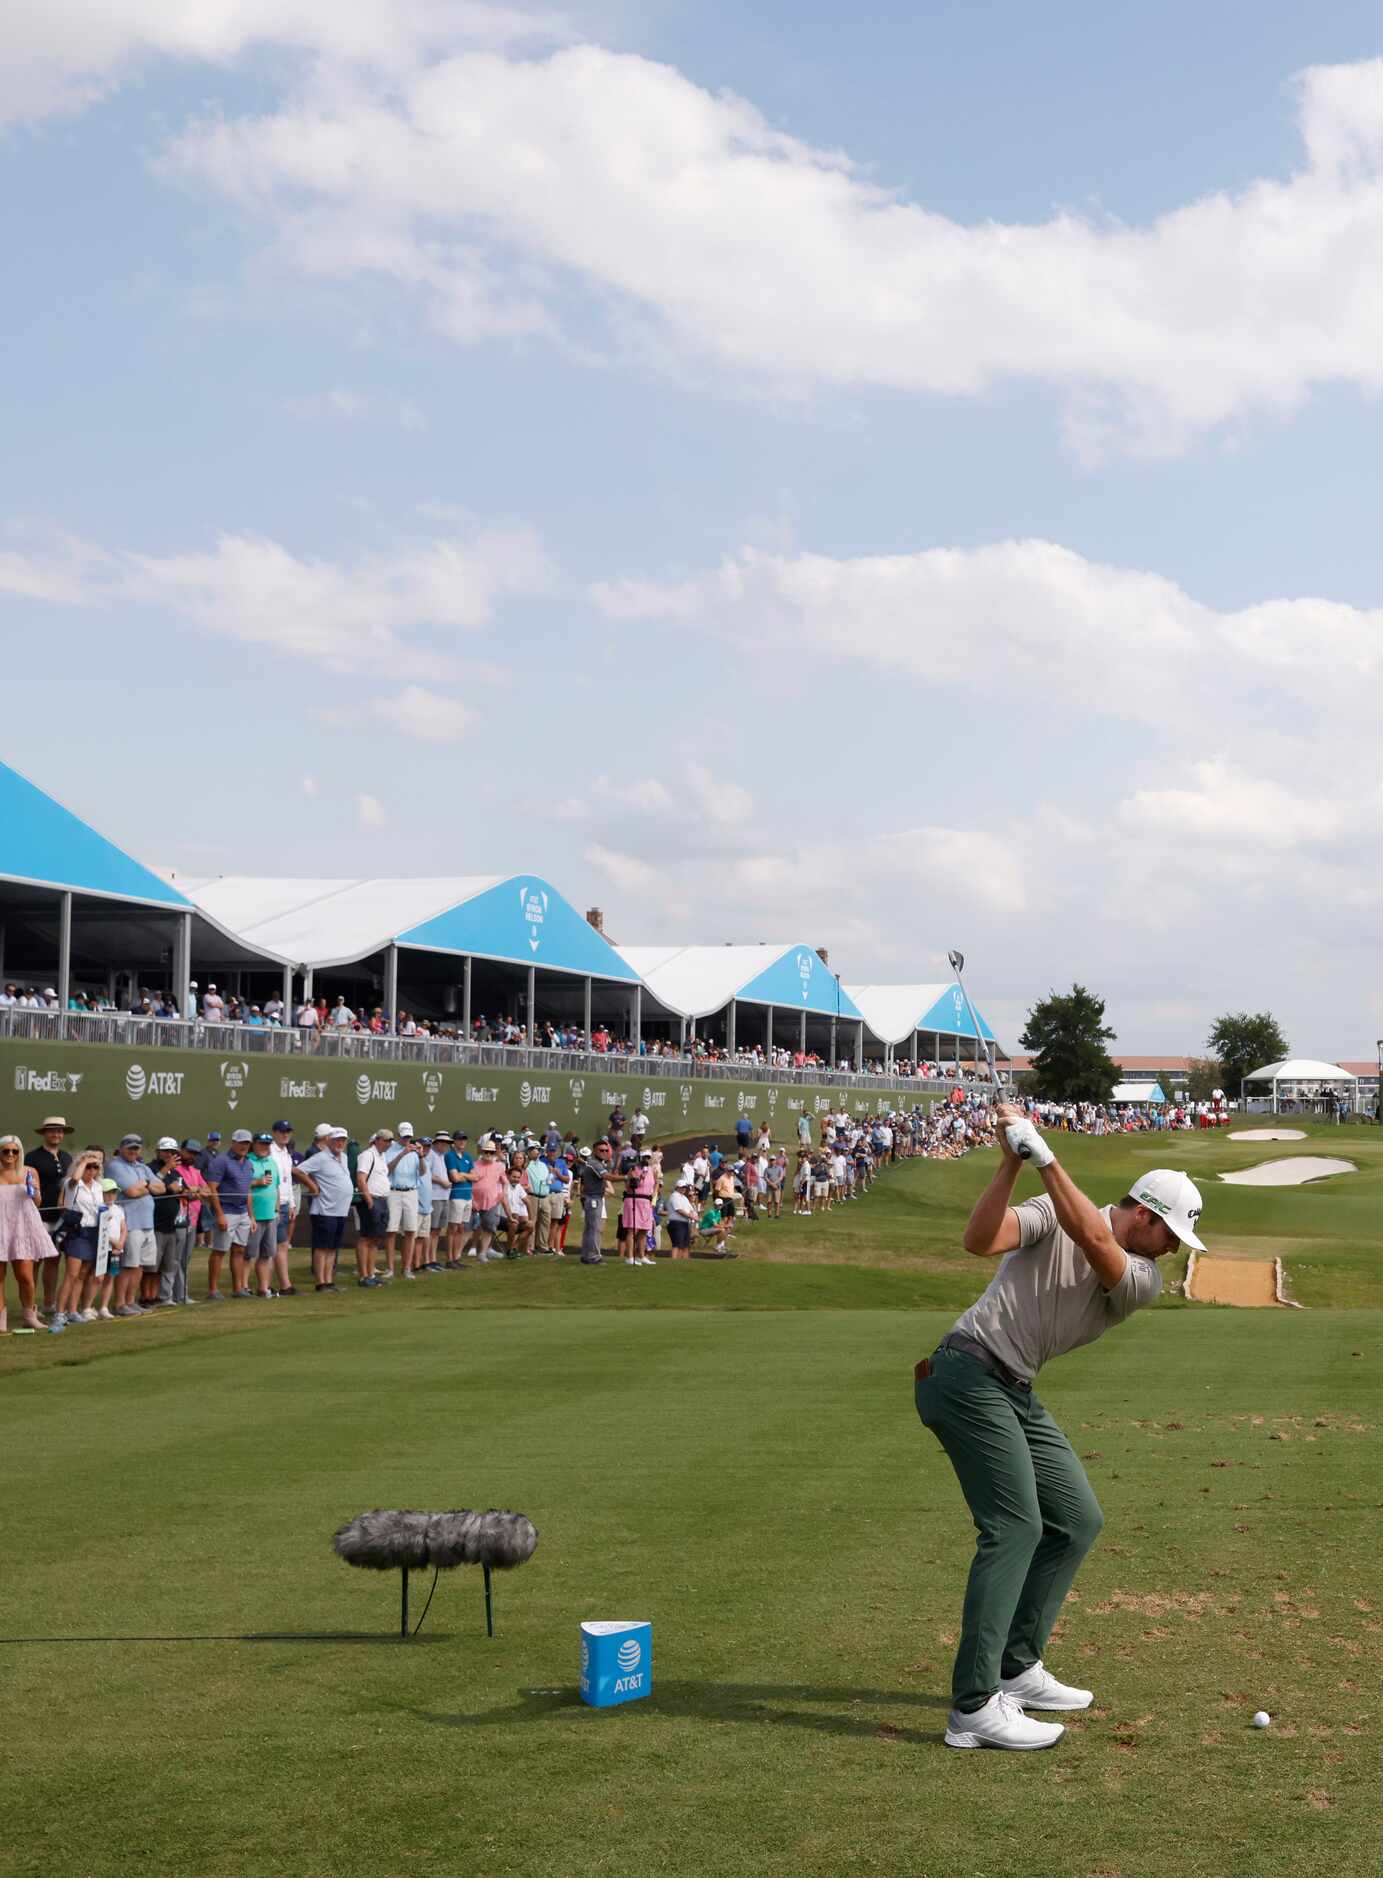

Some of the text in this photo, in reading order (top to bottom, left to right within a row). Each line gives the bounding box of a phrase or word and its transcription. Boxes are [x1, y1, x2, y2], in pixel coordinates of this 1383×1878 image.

[27, 1070, 67, 1092] FedEx
[147, 1071, 185, 1095] AT&T
[289, 1080, 317, 1098] FedEx
[371, 1081, 398, 1100] AT&T
[532, 1086, 552, 1104] AT&T
[614, 1673, 644, 1694] AT&T
